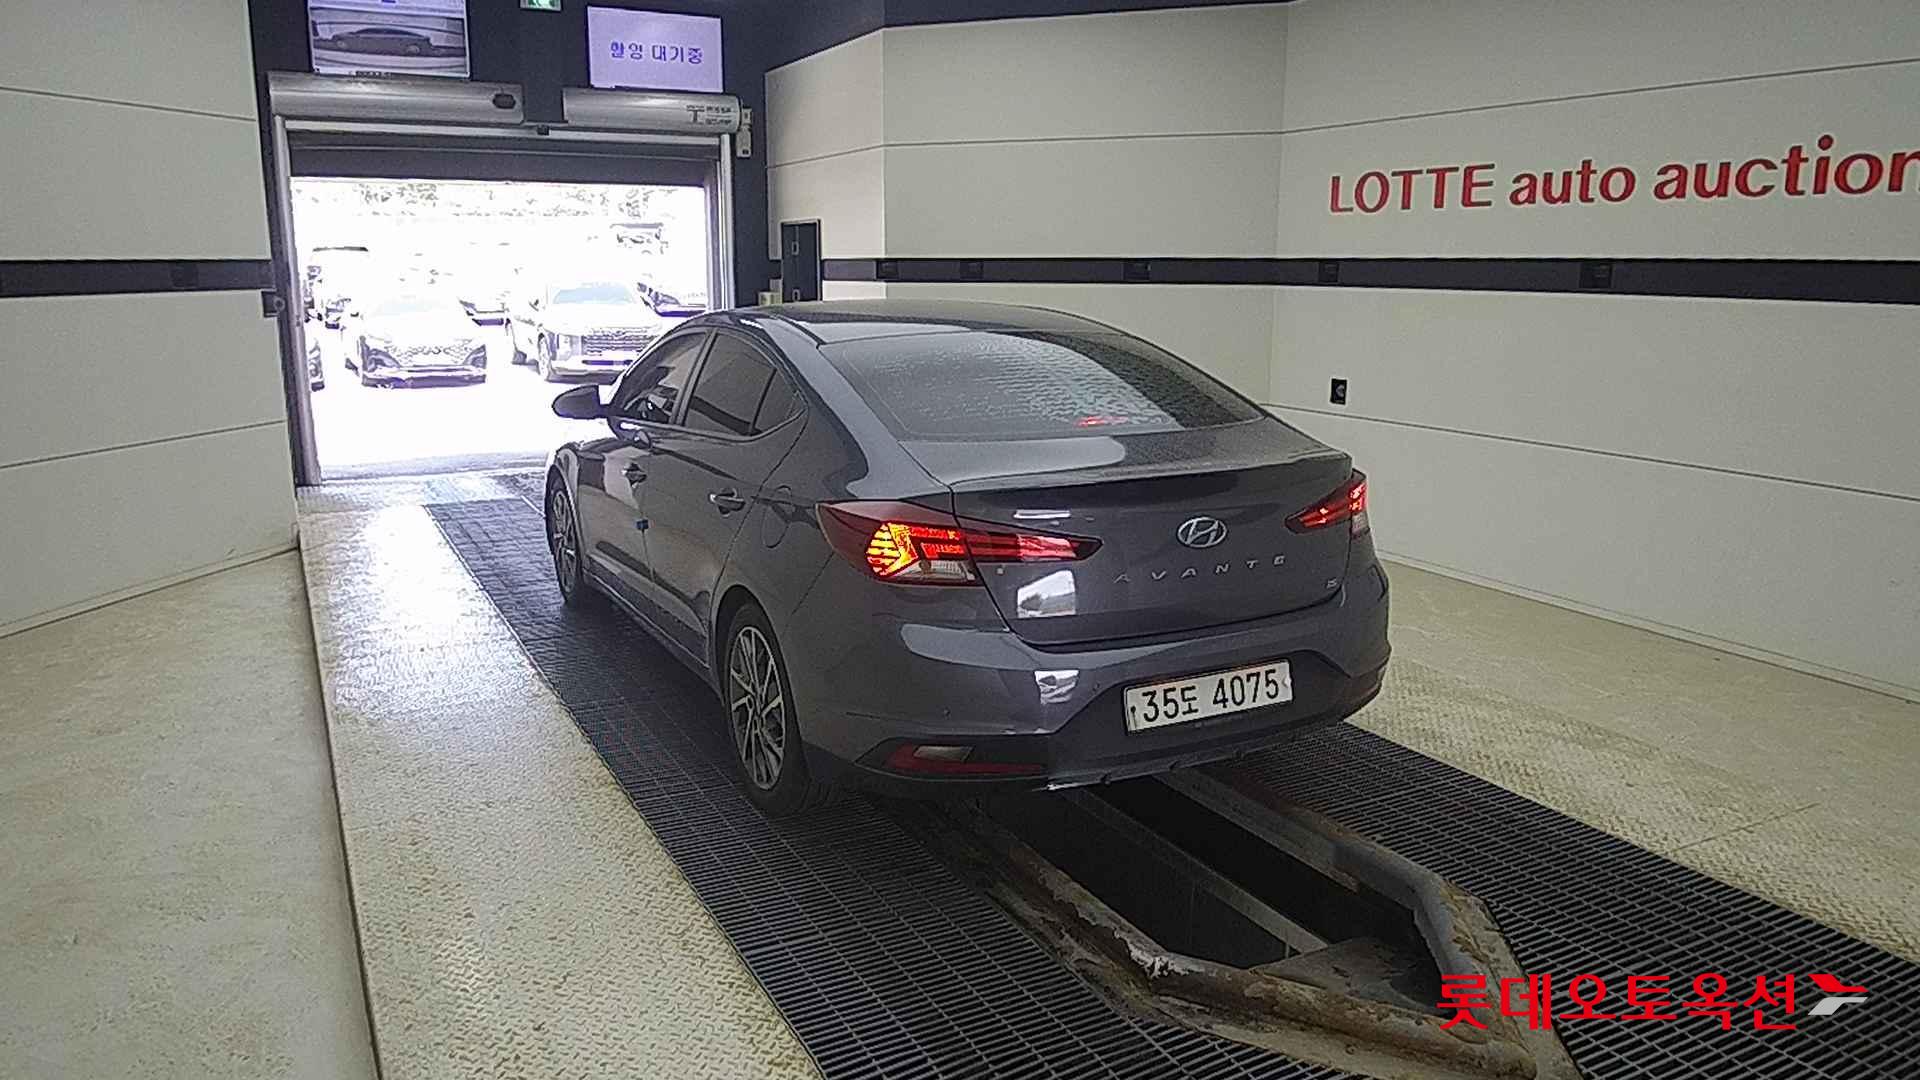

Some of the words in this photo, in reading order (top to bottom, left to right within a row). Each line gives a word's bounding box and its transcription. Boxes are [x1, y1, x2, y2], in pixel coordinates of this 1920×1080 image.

[651, 44, 703, 65] 대기중
[1331, 163, 1496, 213] LOTTE
[1509, 159, 1637, 205] auto
[1112, 554, 1286, 584] AVANTE
[1142, 685, 1199, 723] 35도
[1212, 669, 1279, 709] 4075
